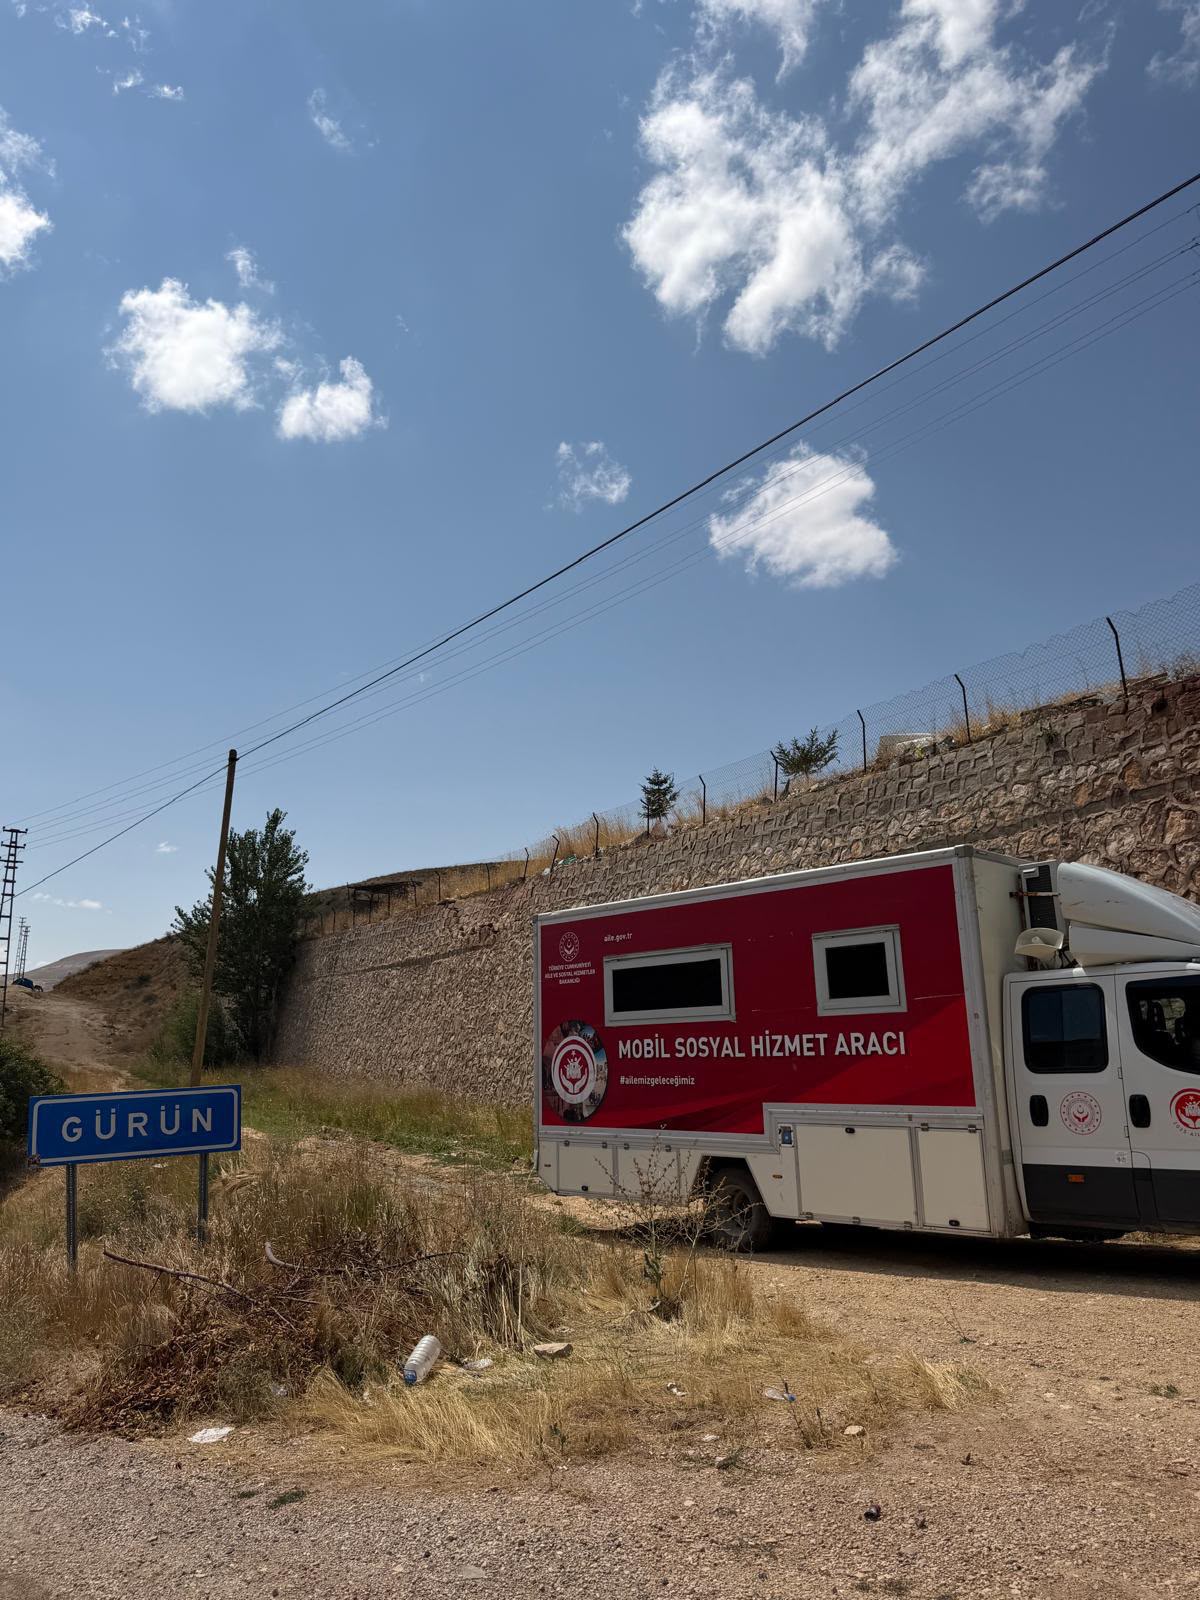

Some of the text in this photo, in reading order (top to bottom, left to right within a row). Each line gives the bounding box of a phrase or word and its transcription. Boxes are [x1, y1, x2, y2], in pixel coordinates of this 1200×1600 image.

[604, 932, 631, 942] aile.gov.tr
[618, 1030, 906, 1059] MOBİL SOSYAL HİZMET ARACI
[620, 1074, 695, 1087] #ailemizgeleceğimiz
[61, 1104, 212, 1143] GÜRÜN
